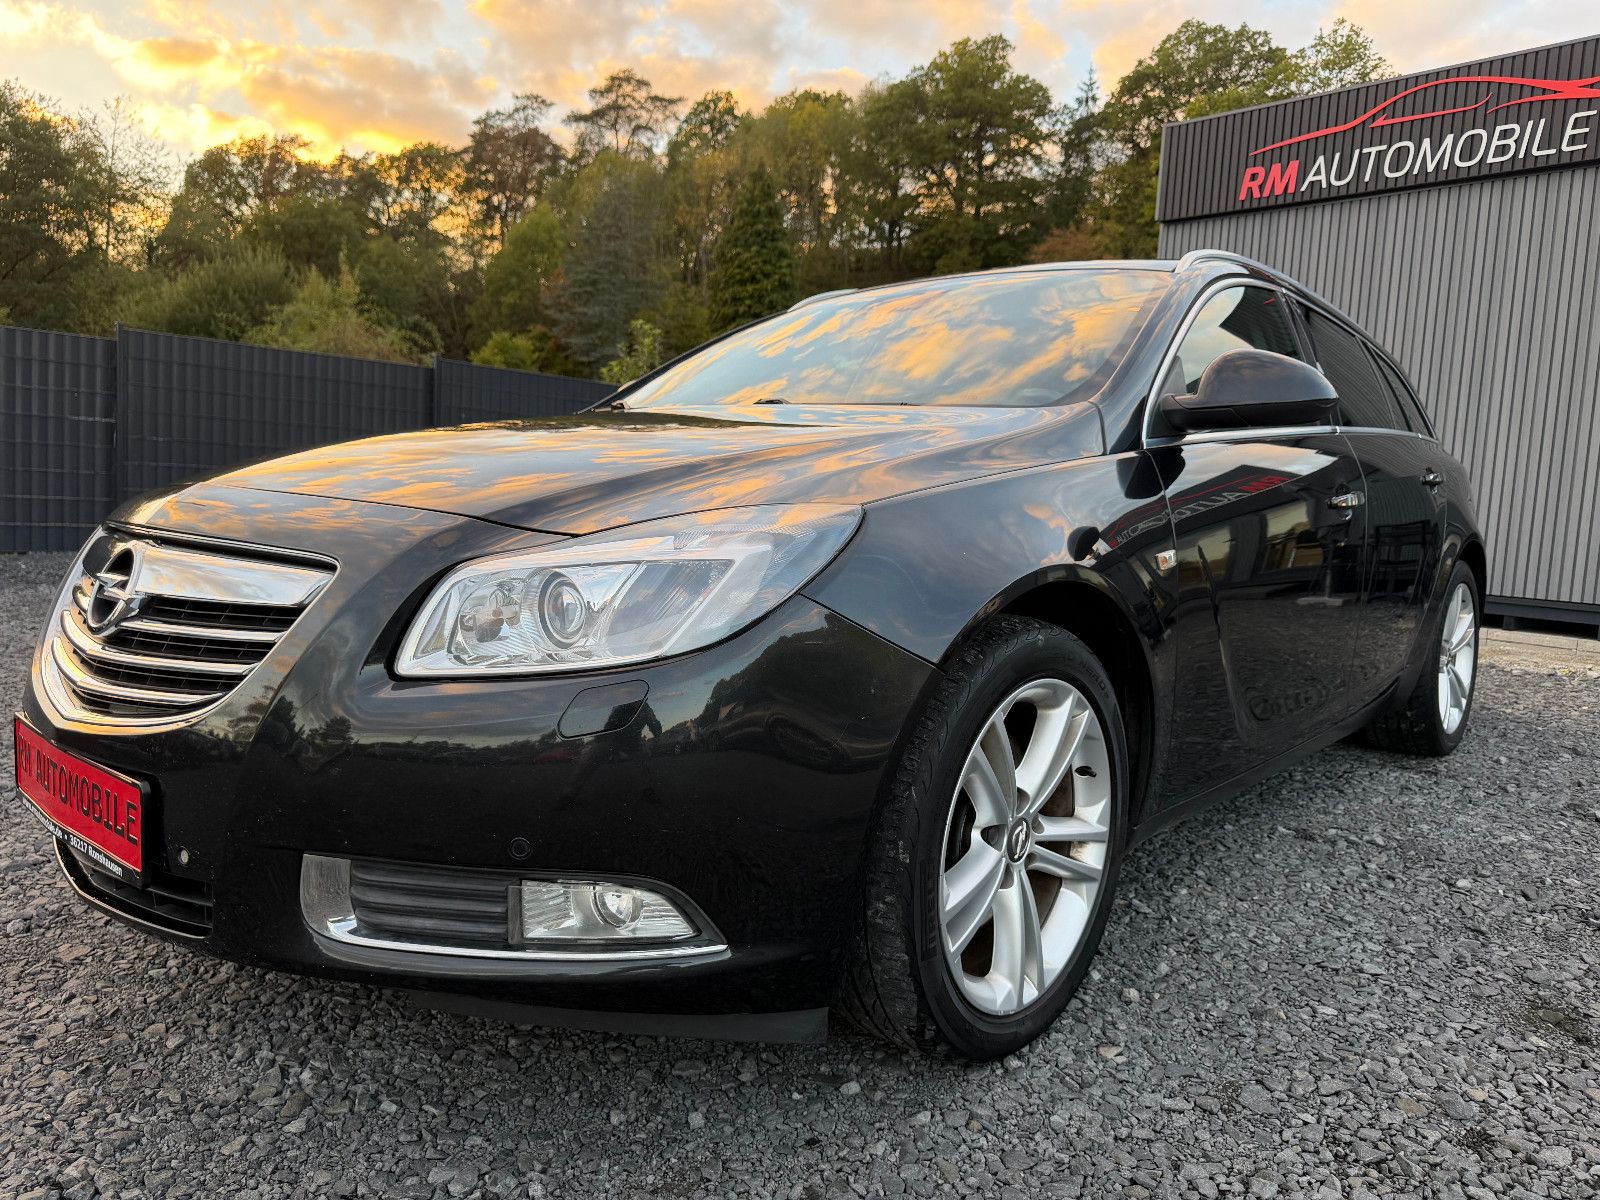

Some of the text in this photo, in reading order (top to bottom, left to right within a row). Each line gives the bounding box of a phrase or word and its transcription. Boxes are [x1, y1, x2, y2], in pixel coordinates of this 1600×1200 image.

[1238, 109, 1597, 200] RM AUTOMOBILE
[17, 733, 138, 846] RM AUTOMOBILE
[69, 835, 87, 853] 36217
[88, 845, 122, 877] Ronshausen
